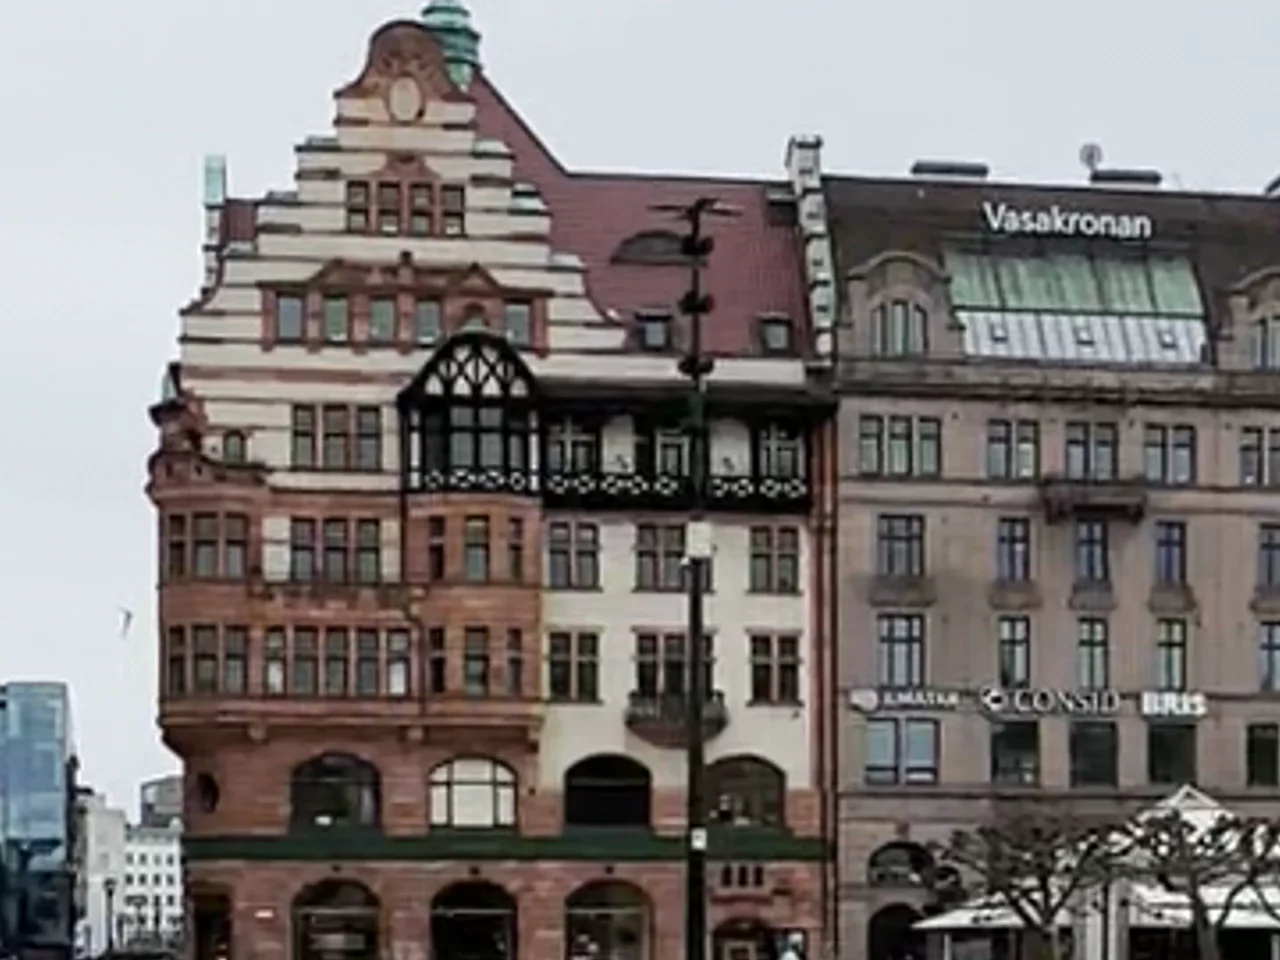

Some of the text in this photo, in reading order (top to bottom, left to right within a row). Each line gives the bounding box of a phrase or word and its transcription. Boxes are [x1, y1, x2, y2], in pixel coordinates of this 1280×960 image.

[983, 201, 1152, 238] Vasakronan
[1014, 689, 1120, 713] CONSID
[1141, 691, 1207, 716] BRIS
